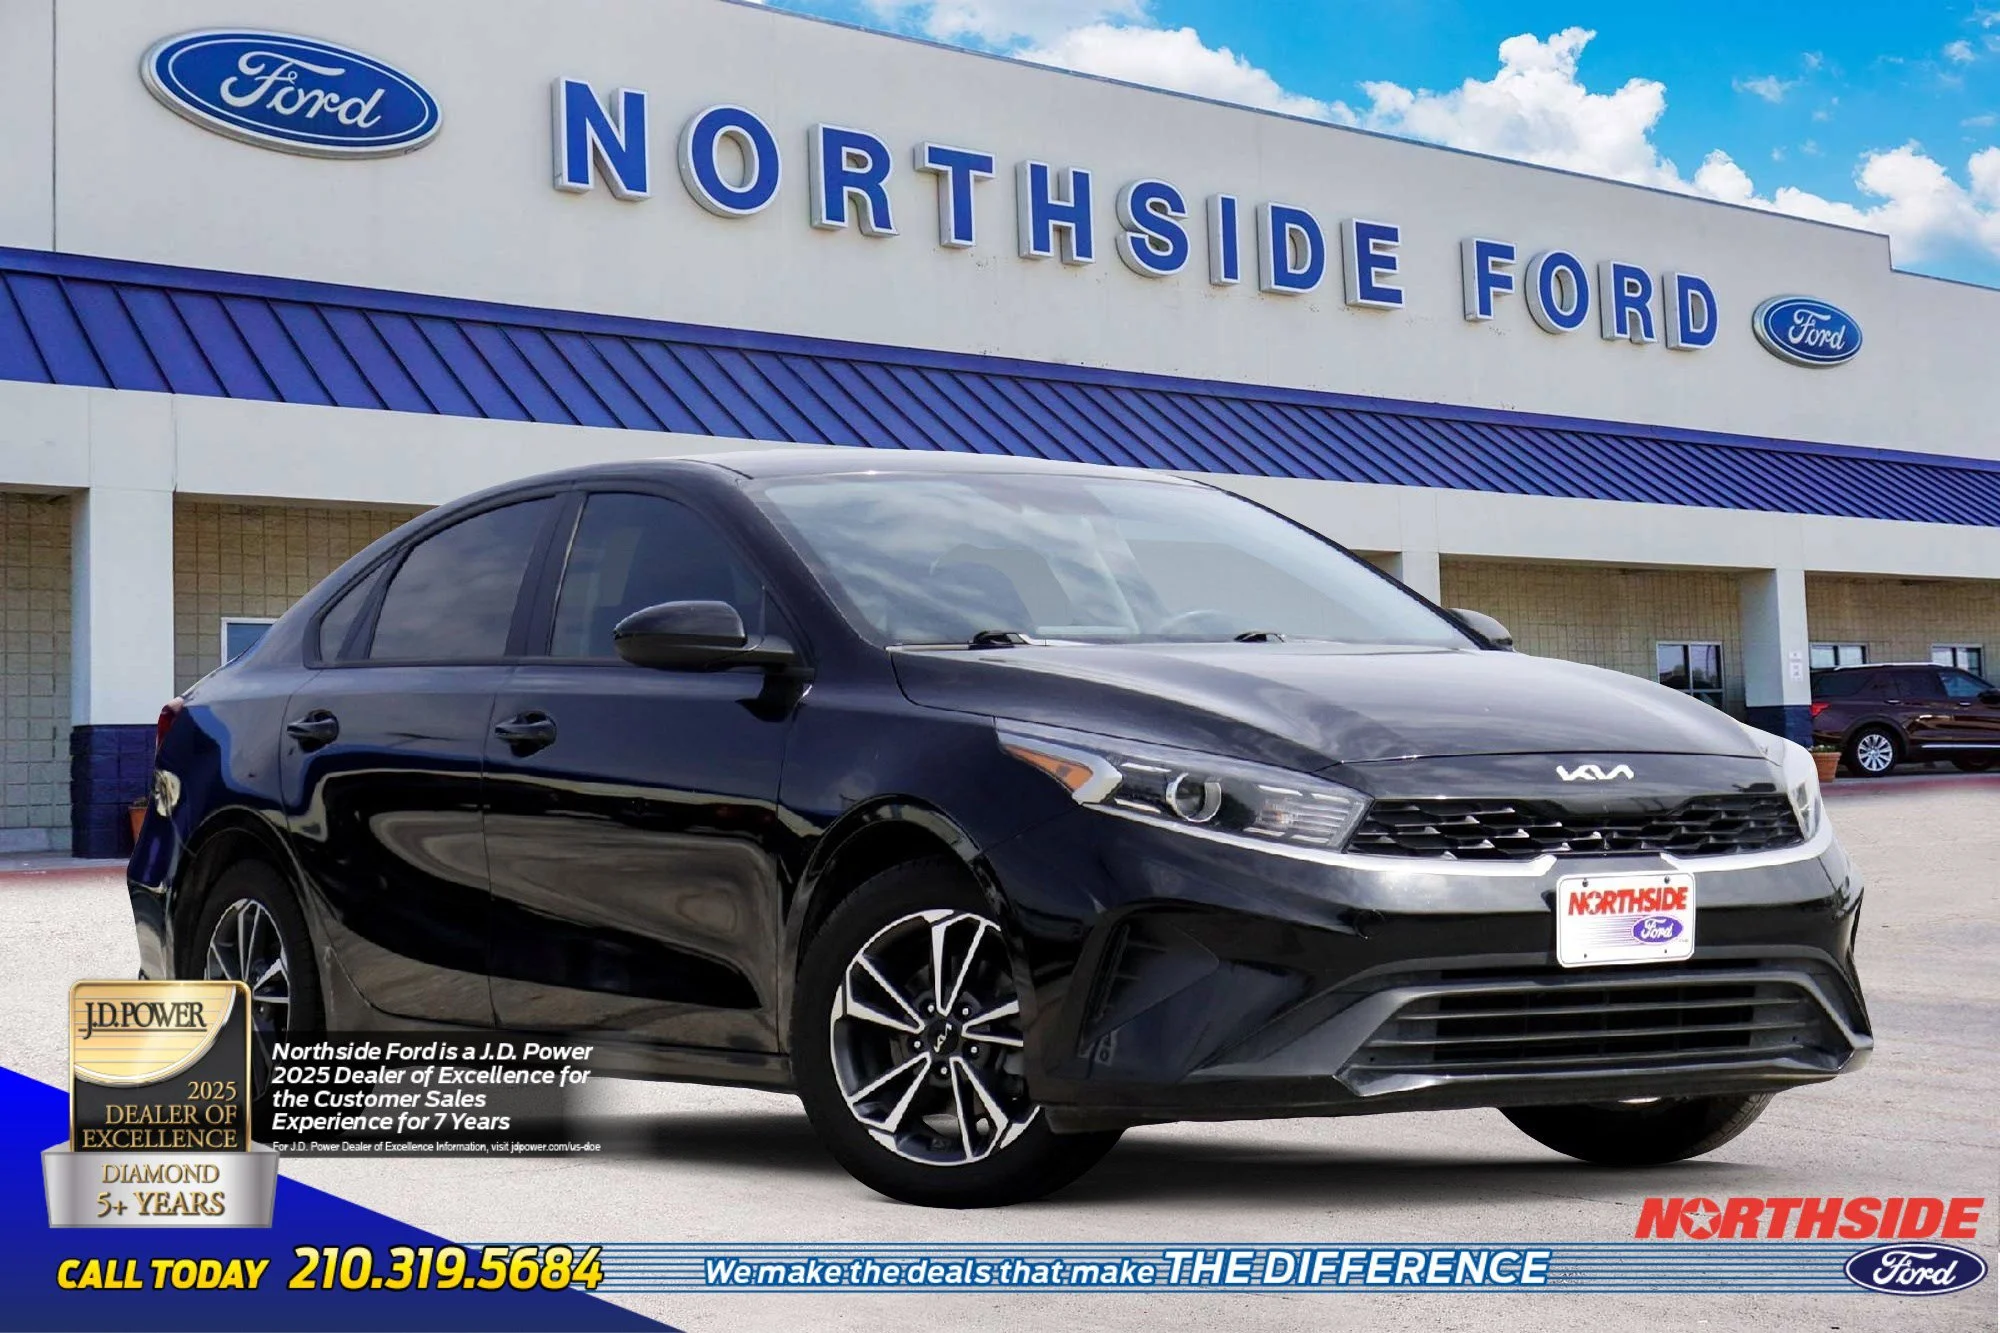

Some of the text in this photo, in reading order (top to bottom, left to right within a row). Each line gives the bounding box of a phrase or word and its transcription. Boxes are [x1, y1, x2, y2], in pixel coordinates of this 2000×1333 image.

[219, 51, 386, 129] Ford
[552, 75, 1719, 351] NORTHSIDE FORD
[1788, 309, 1847, 351] Ford
[1568, 886, 1689, 917] NORTHSIDE
[1640, 918, 1675, 939] Ford
